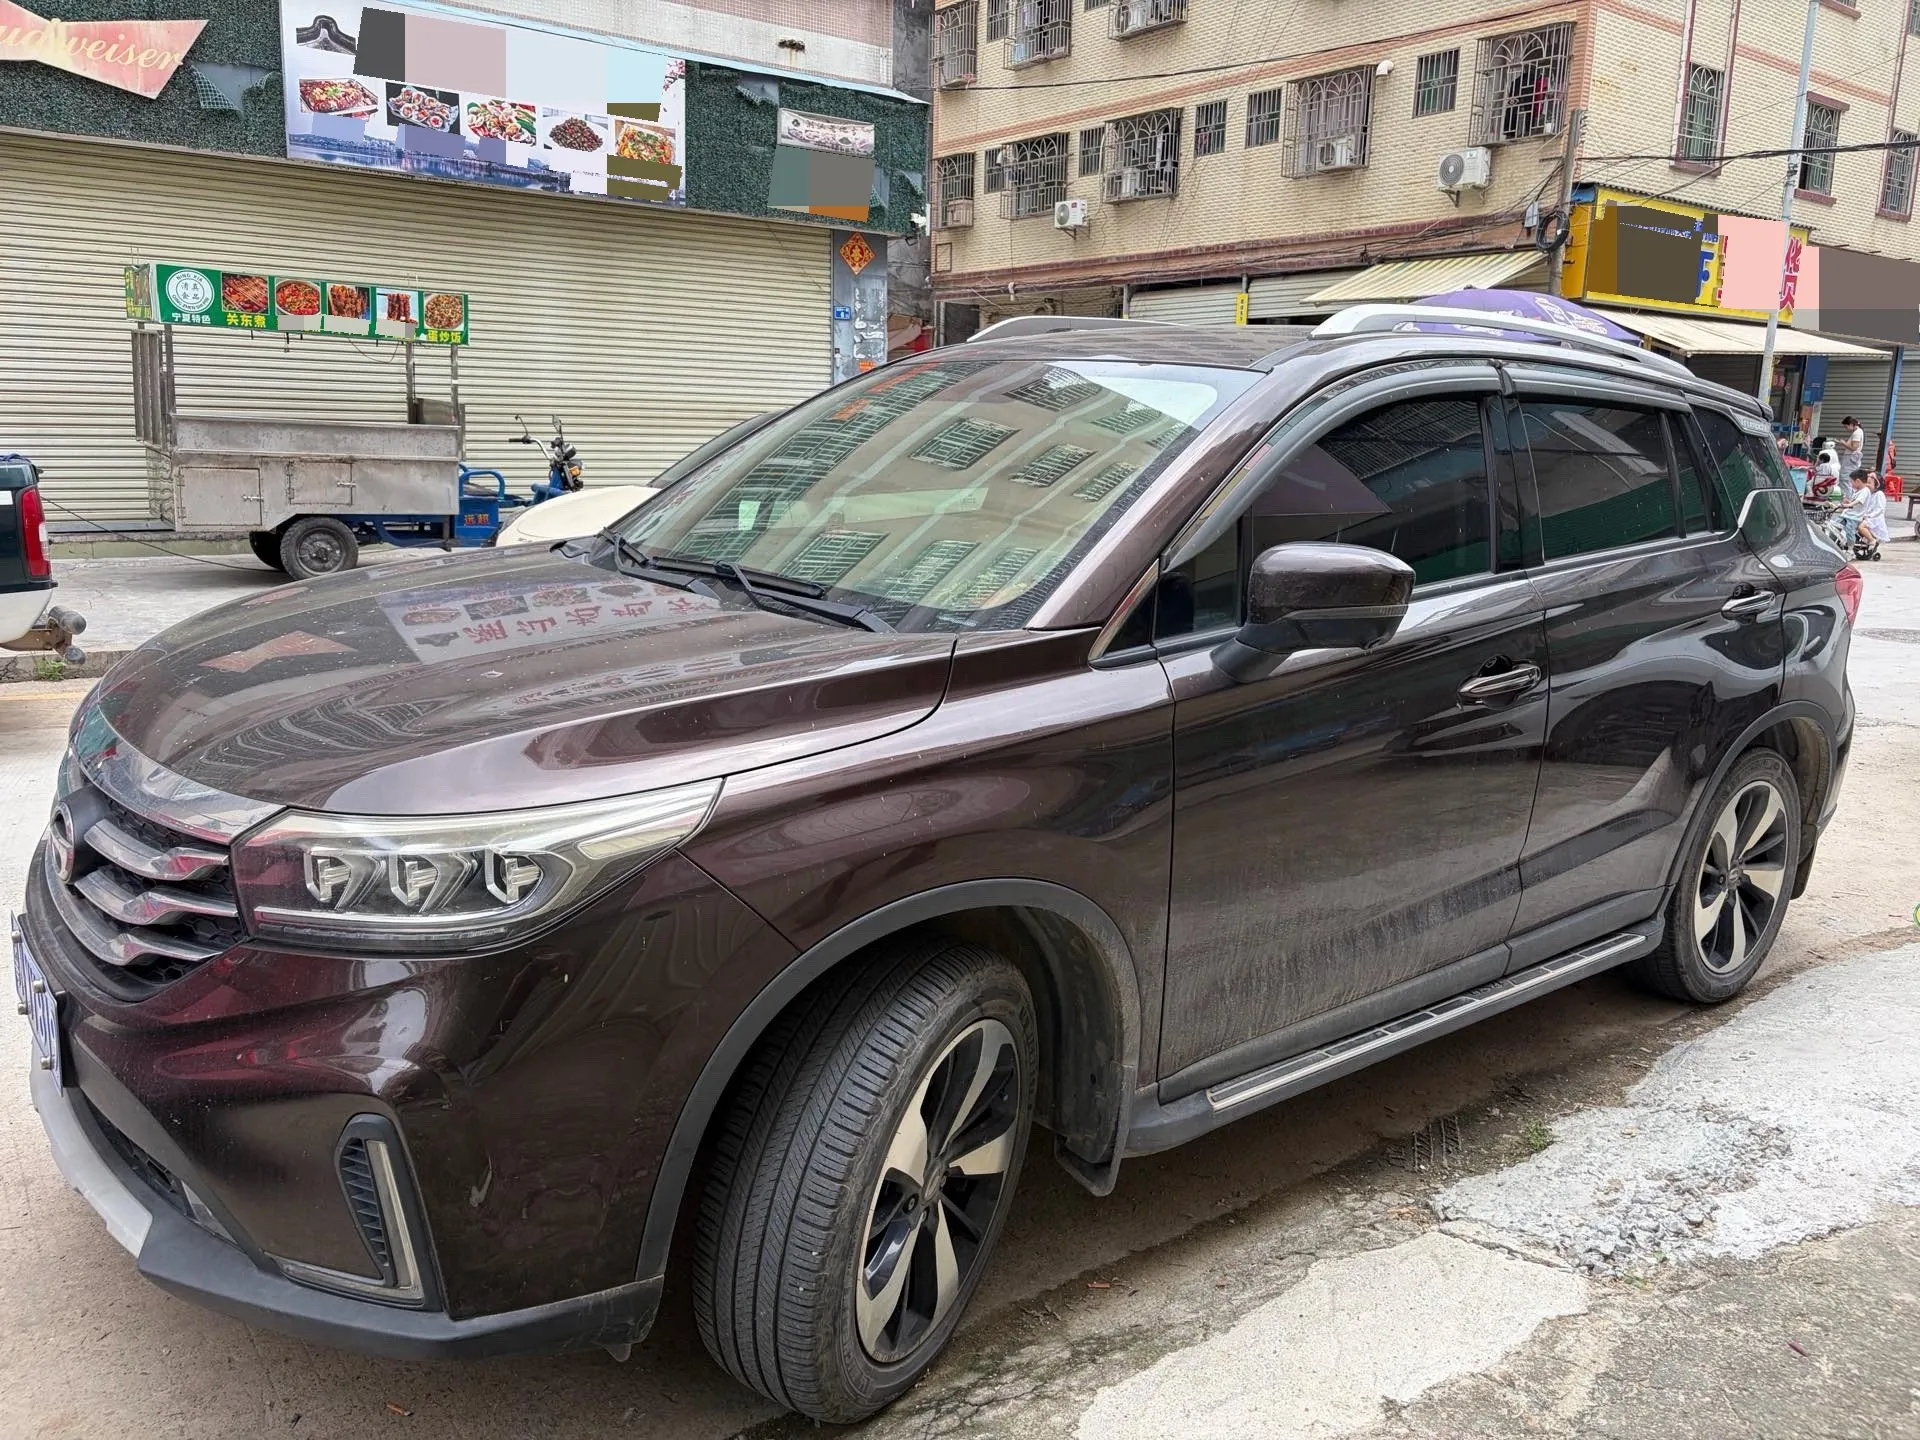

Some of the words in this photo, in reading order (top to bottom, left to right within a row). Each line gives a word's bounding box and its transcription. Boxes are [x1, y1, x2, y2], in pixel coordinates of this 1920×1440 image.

[171, 312, 211, 325] 宁夏特色
[226, 313, 266, 328] 关东煮
